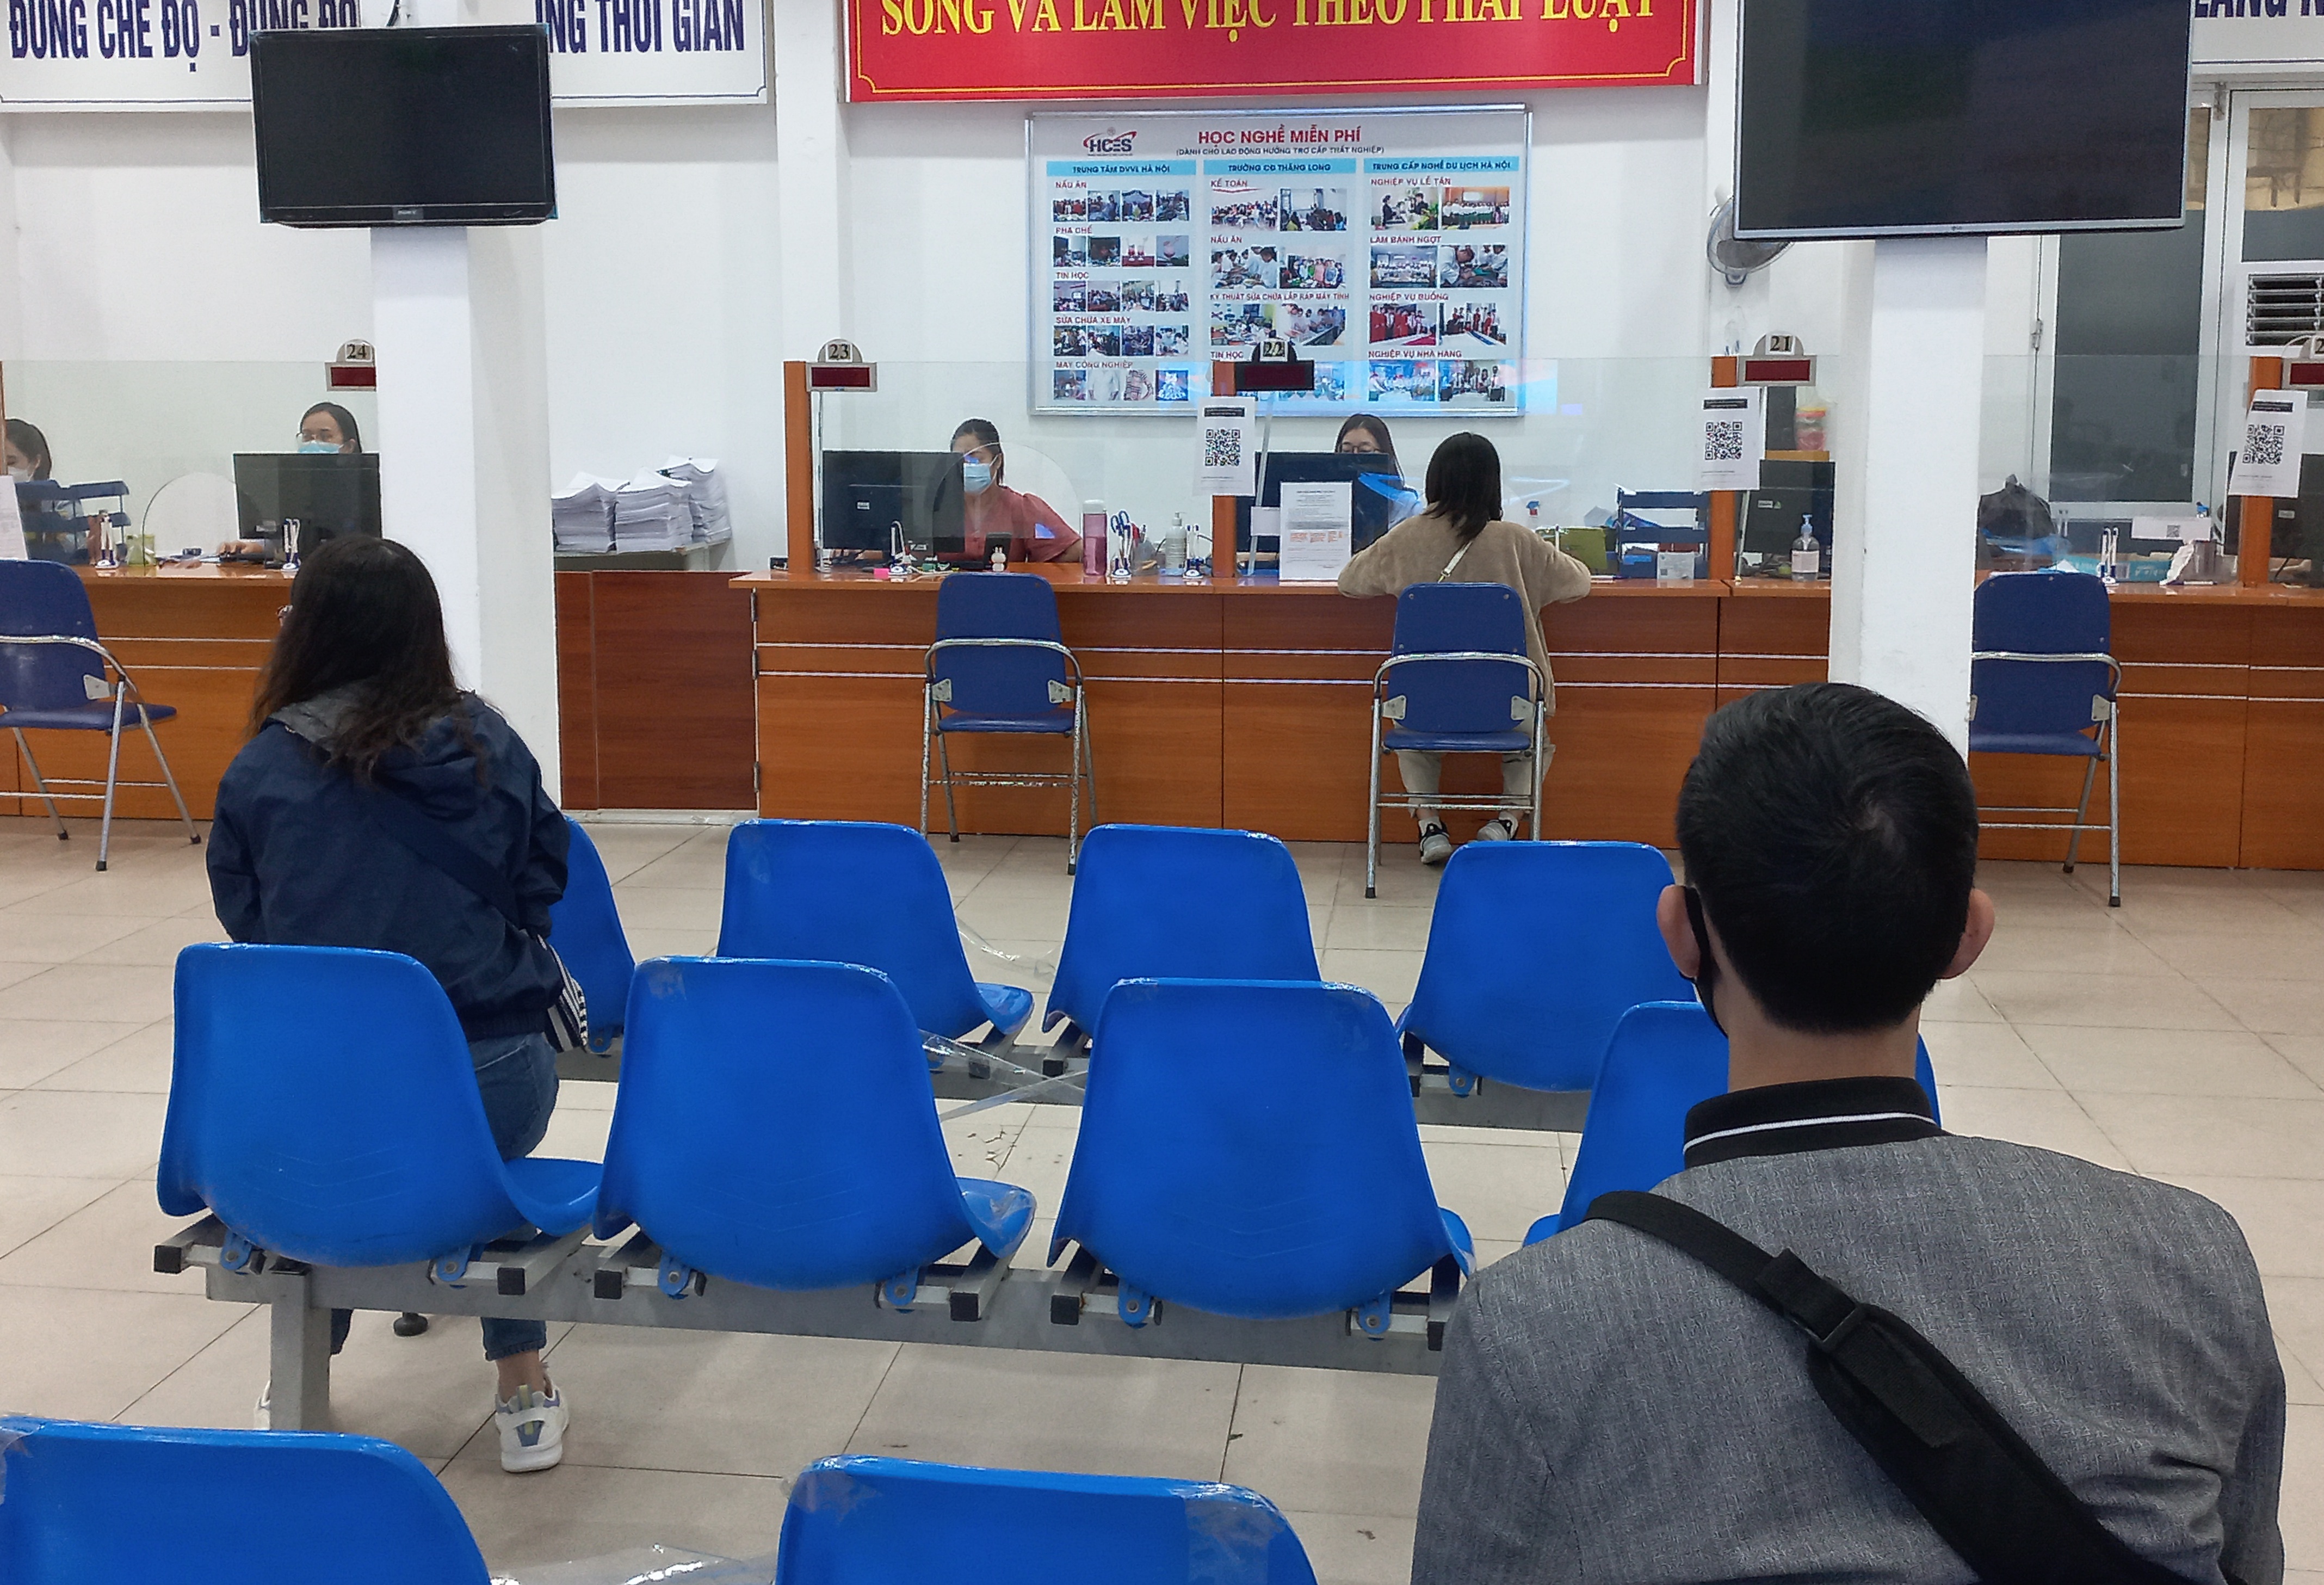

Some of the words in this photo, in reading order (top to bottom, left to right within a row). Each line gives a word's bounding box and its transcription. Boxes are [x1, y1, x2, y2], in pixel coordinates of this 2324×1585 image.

[673, 0, 745, 52] GIAN
[1198, 131, 1235, 147] HỌC
[1240, 124, 1285, 143] NGHỀ
[1290, 125, 1329, 143] MIỄN
[1334, 126, 1362, 143] PHÍ
[1090, 139, 1132, 152] HCES
[347, 343, 367, 359] 24
[829, 343, 849, 359] 23
[1263, 341, 1283, 357] 22
[1770, 335, 1791, 351] 21
[2315, 337, 2324, 354] 2
